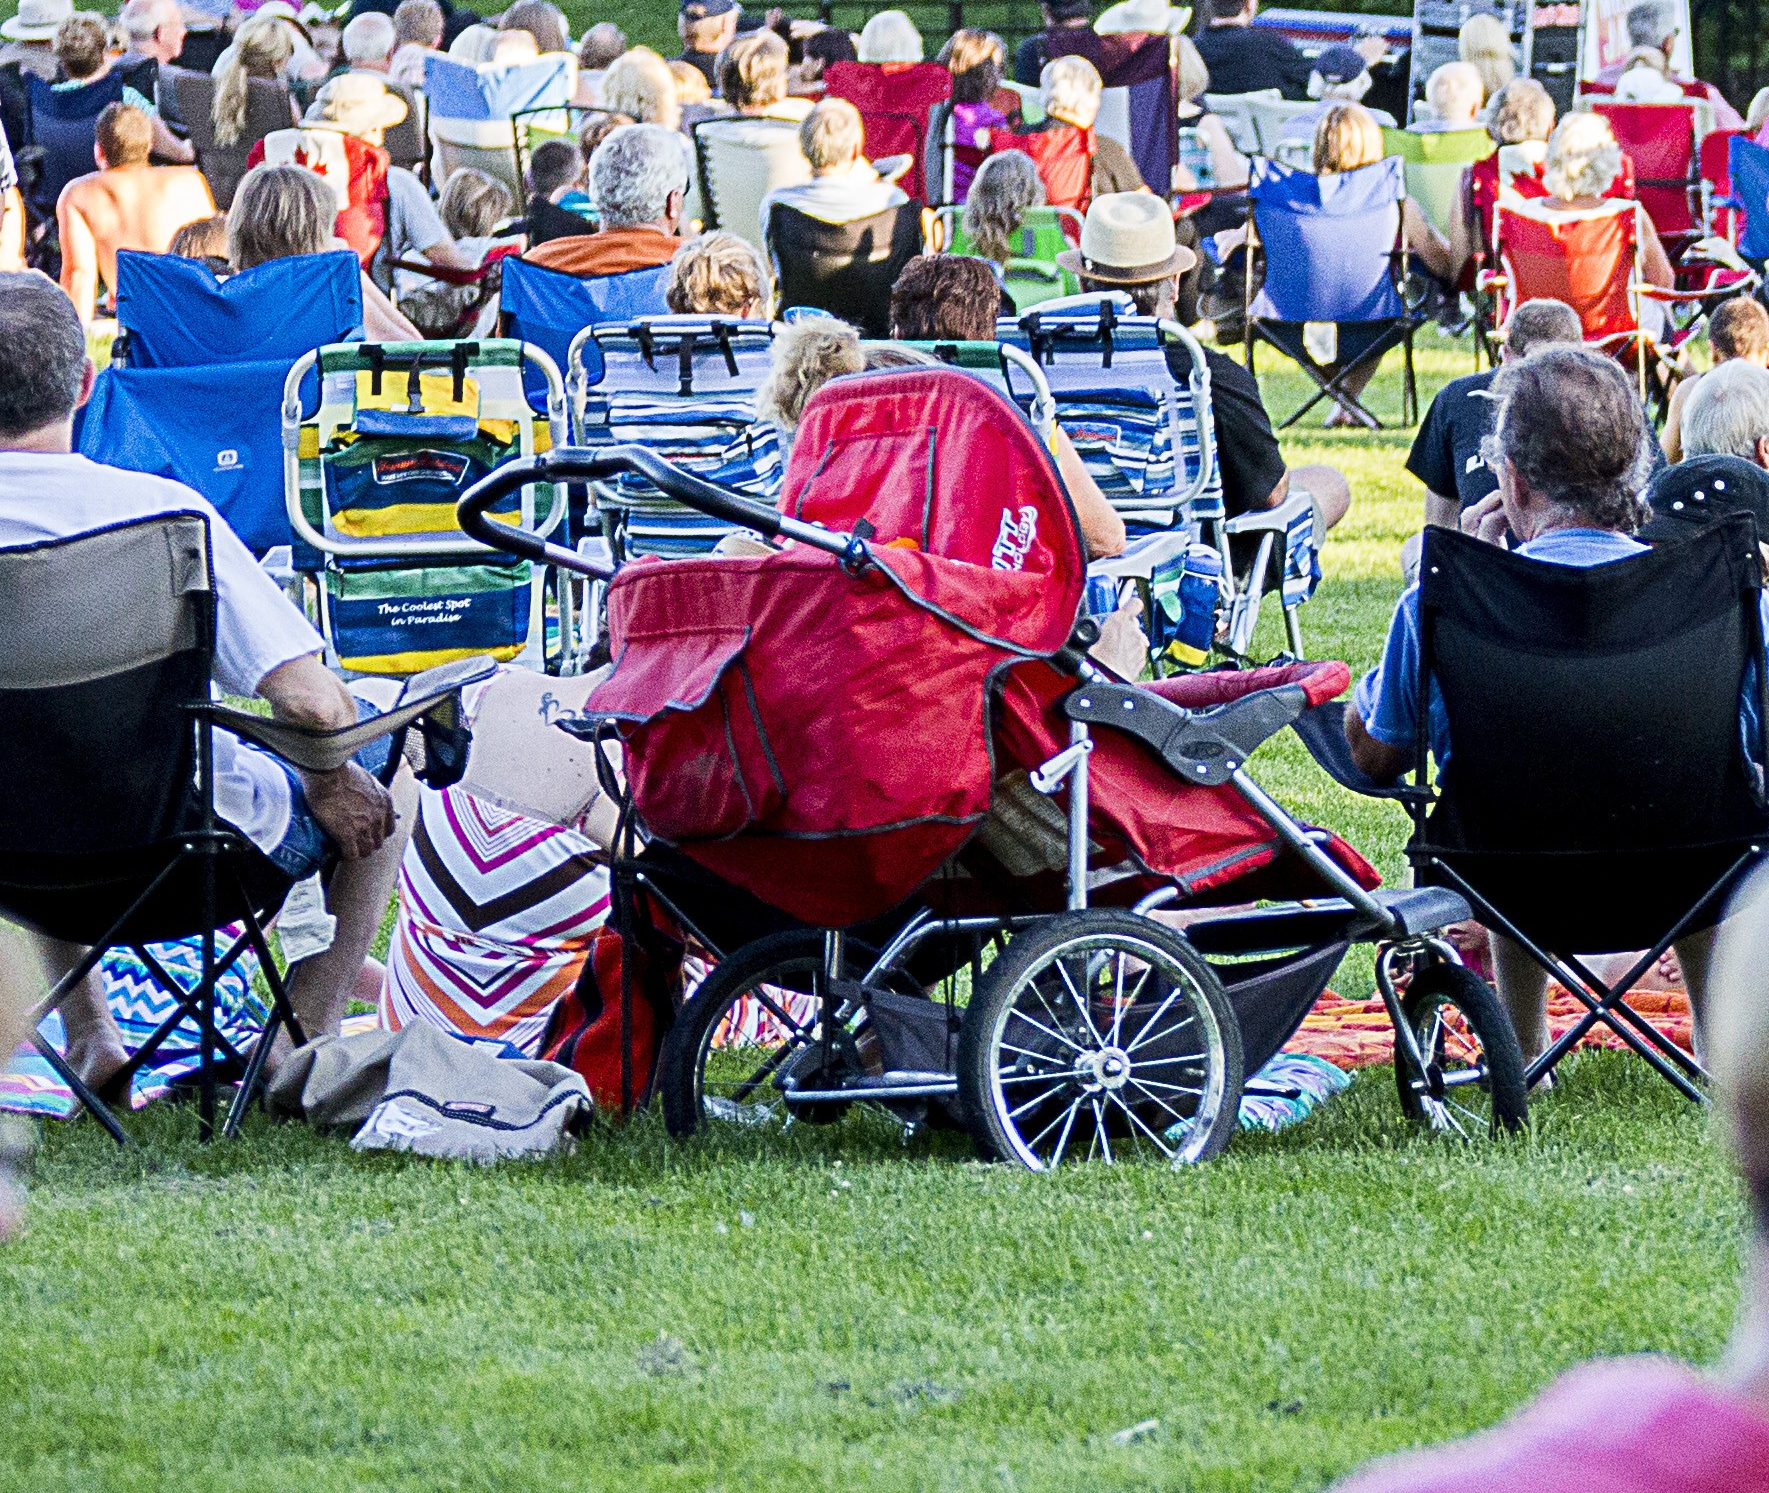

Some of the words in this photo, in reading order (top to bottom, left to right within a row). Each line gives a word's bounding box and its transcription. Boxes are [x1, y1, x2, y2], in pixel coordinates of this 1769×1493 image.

[378, 602, 400, 615] The
[401, 600, 445, 613] Coolest
[445, 597, 472, 612] Spot
[391, 616, 406, 627] in
[407, 612, 463, 626] Paradise
